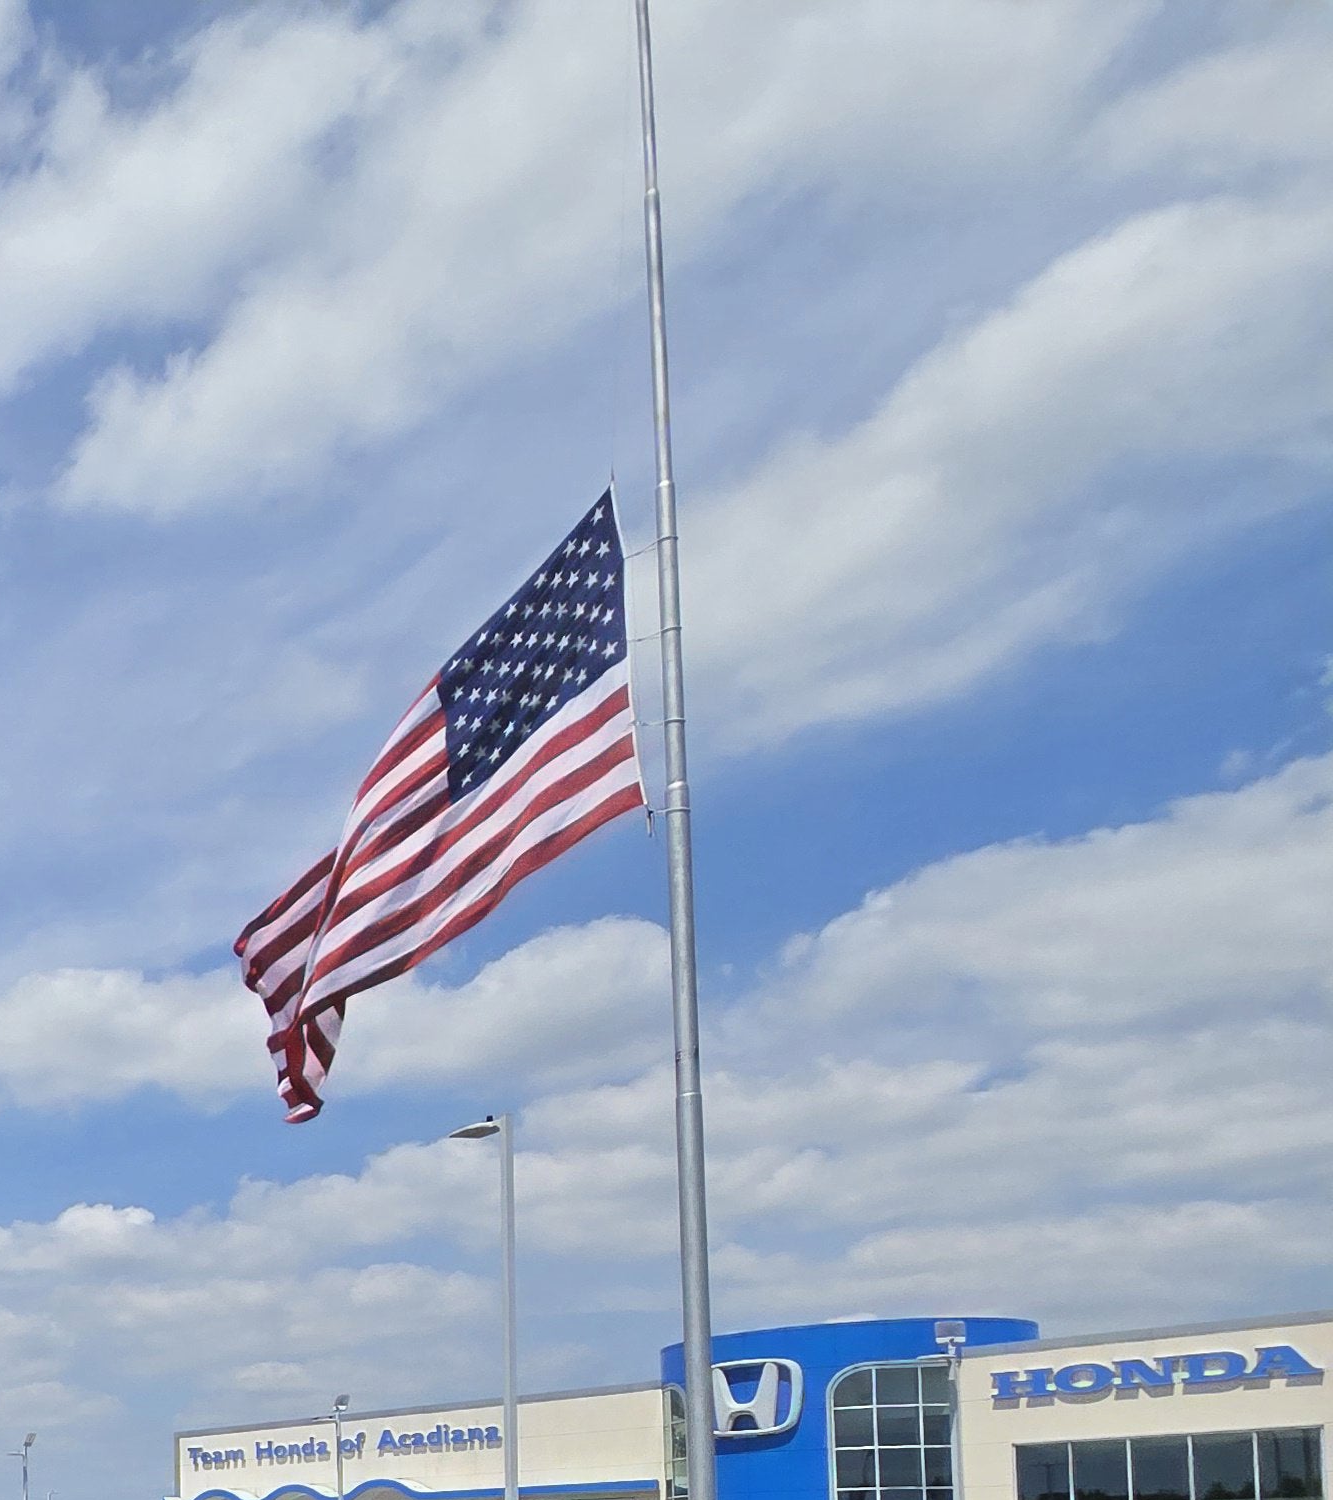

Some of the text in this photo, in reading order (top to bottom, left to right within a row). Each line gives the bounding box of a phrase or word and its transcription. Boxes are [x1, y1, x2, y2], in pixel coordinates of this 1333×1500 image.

[990, 1345, 1325, 1400] HONDA
[188, 1424, 503, 1465] Team Honda of Acadiana
